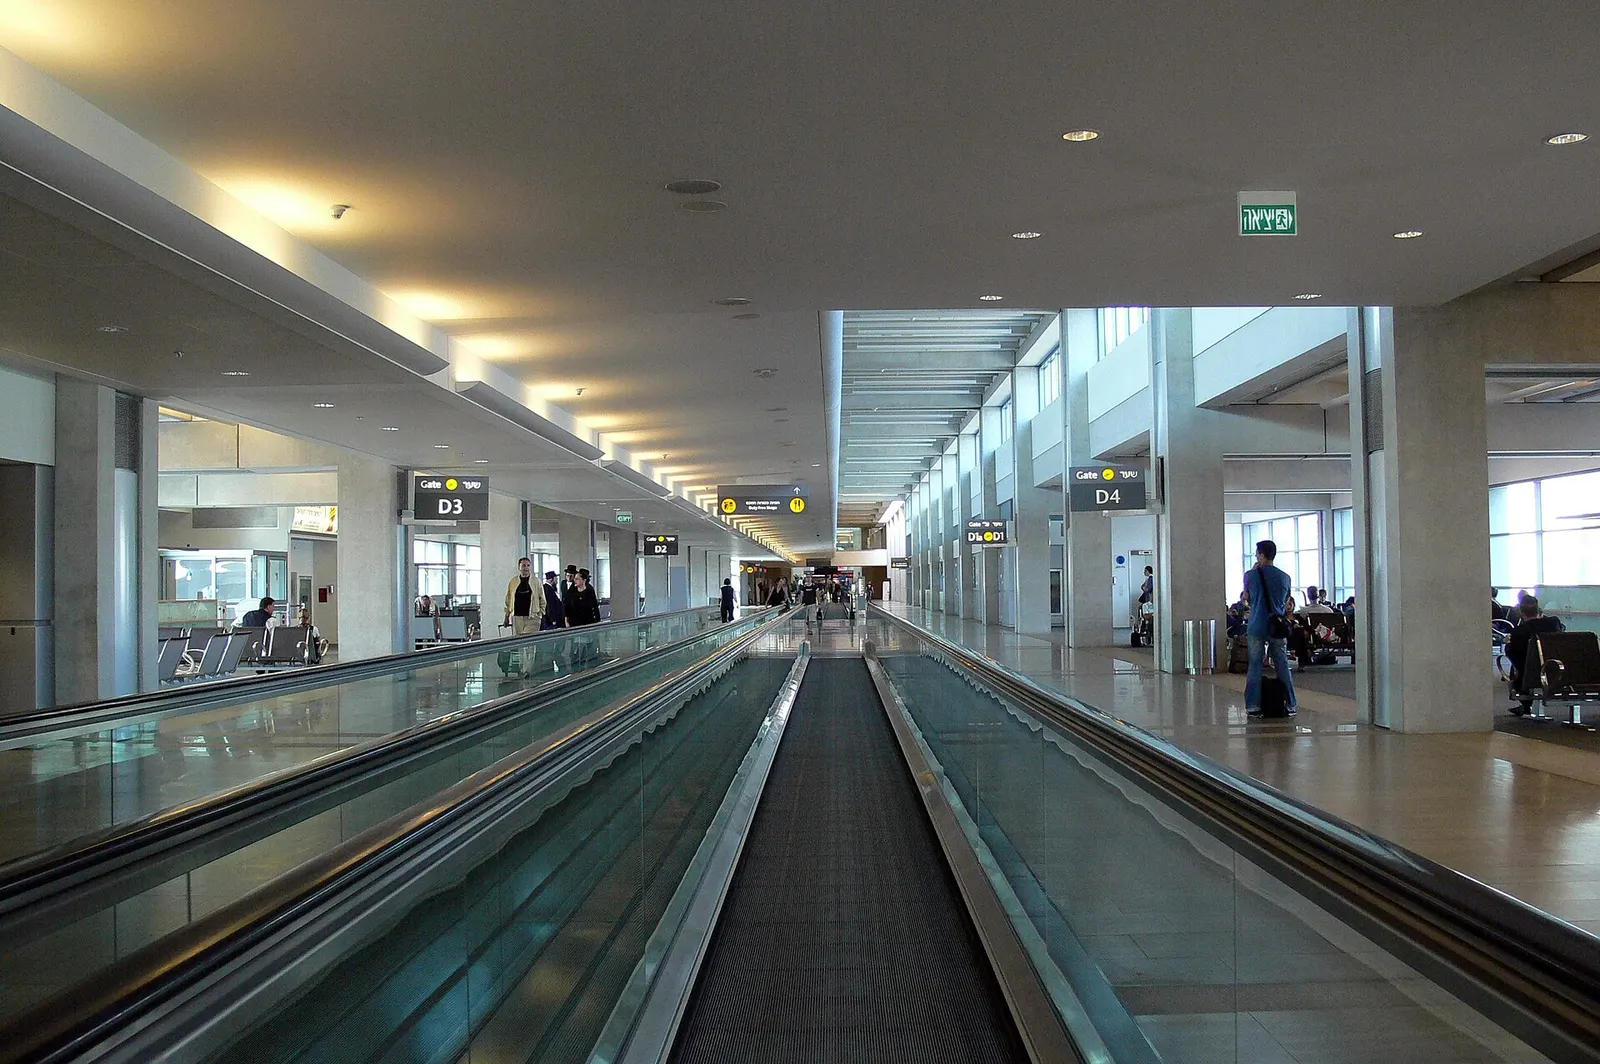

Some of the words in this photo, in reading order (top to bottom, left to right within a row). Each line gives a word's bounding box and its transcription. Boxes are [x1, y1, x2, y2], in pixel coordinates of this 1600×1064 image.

[1243, 208, 1274, 231] יציאה
[1075, 471, 1098, 480] Gate
[1119, 470, 1138, 479] שער
[420, 480, 442, 489] Gate
[462, 481, 481, 490] שער
[1095, 488, 1121, 505] D4
[438, 498, 463, 515] D3
[992, 531, 1004, 541] D1
[654, 545, 668, 553] D2
